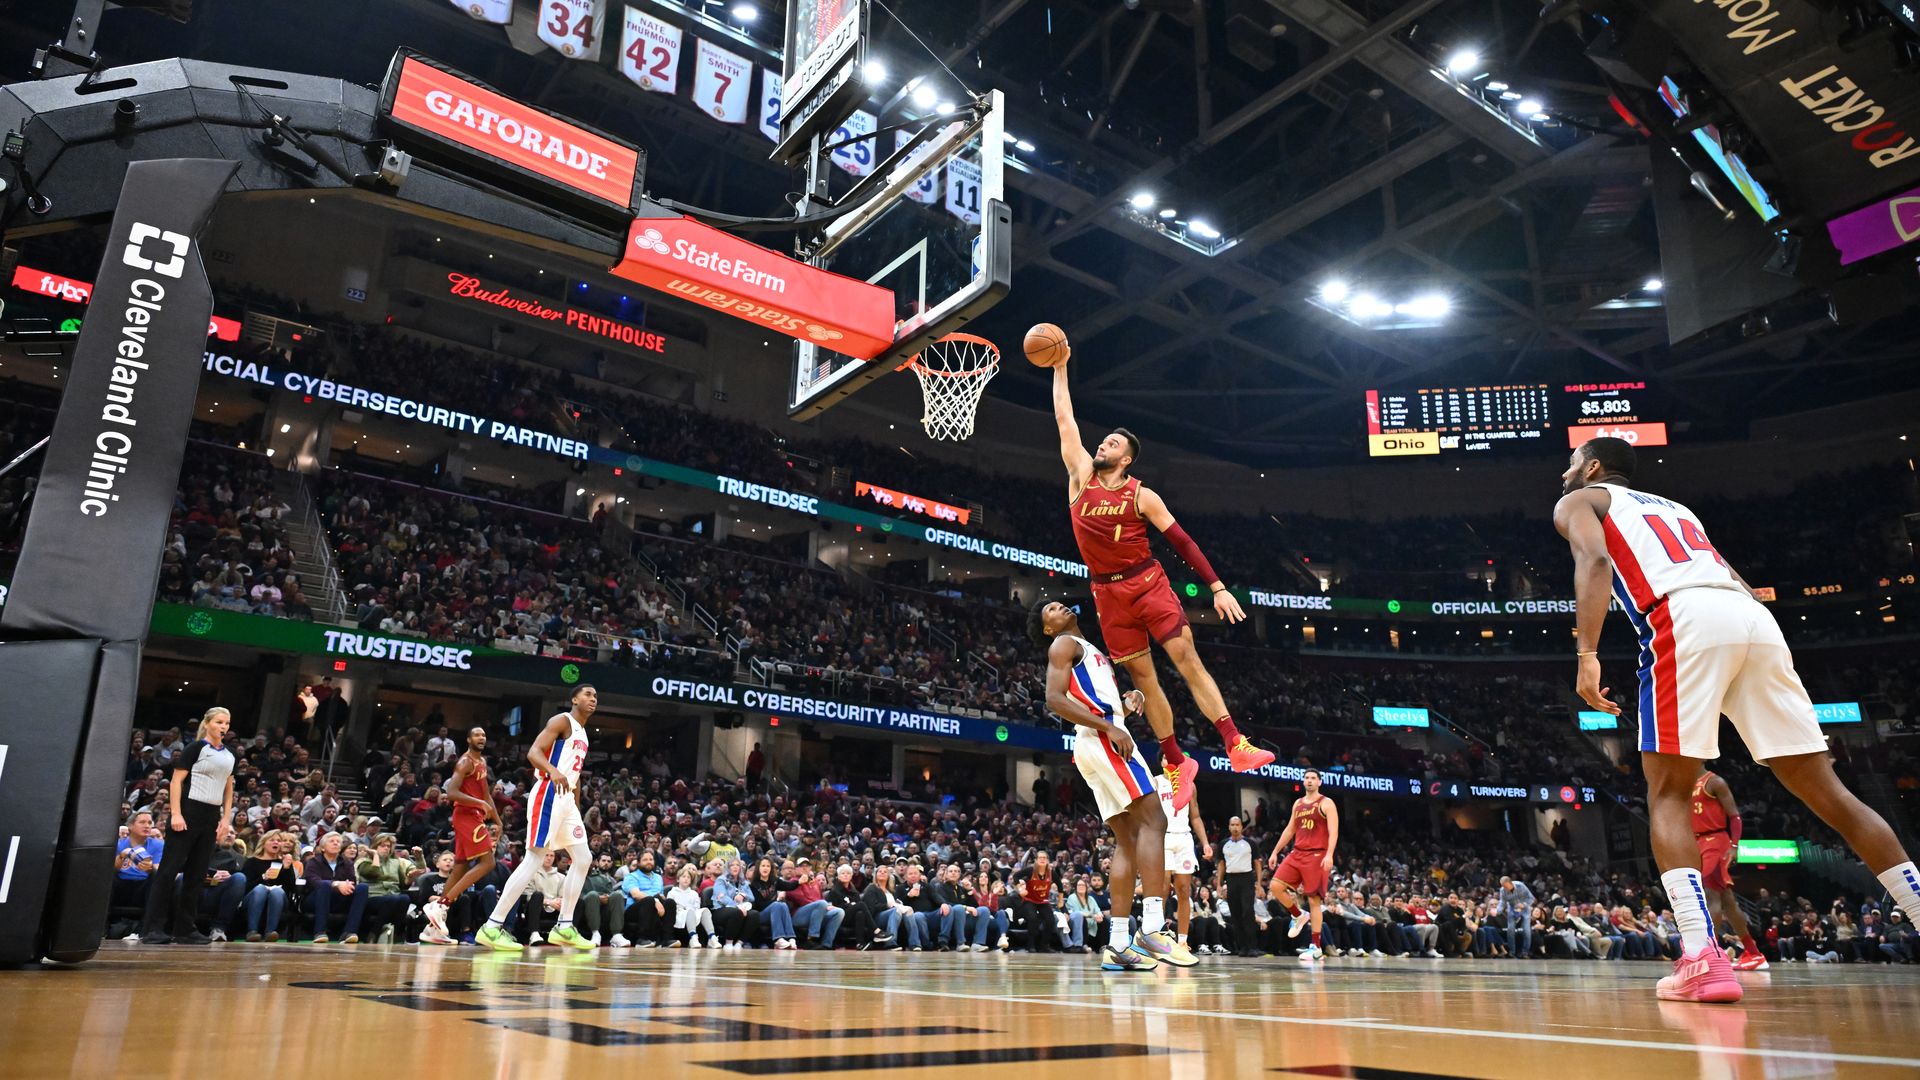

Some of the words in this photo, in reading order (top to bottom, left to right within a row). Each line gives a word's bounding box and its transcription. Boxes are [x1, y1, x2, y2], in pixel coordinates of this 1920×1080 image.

[547, 2, 595, 49] 34
[626, 20, 677, 49] THURMOND
[639, 16, 666, 34] NATE
[626, 37, 671, 82] 42
[707, 58, 740, 77] SMITH
[714, 71, 732, 105] 7
[766, 97, 781, 130] 2
[1779, 64, 1920, 169] ROCKET
[425, 90, 609, 180] GATORADE
[834, 126, 871, 165] 25
[954, 180, 980, 214] 11
[40, 276, 88, 301] fubo
[447, 271, 563, 322] Budweiser
[566, 308, 666, 353] PENTHOUSE
[102, 278, 166, 426] Cleveland
[1599, 381, 1646, 391] RAFFLE
[201, 352, 275, 386] ICIAL
[283, 371, 486, 434] CYBERSECURITY
[490, 421, 589, 461] PARTNER
[1581, 399, 1631, 416] $5,803
[1383, 439, 1425, 450] Ohio
[79, 430, 132, 517] Clinic
[716, 475, 818, 515] TRUSTEDSEC
[1080, 500, 1128, 517] Land
[1113, 523, 1122, 542] 1
[1642, 514, 1727, 569] 14
[924, 527, 989, 556] OFFICIAL
[991, 543, 1089, 579] CYBERSECURIT
[1249, 591, 1332, 611] TRUSTEDSEC
[1803, 584, 1842, 596] $5,803
[1431, 601, 1501, 615] OFFICIAL
[324, 630, 473, 670] TRUSTEDSEC
[651, 677, 738, 705] OFFICIAL
[743, 689, 886, 726] CYBERSECURITY
[889, 710, 960, 736] PARTNER
[1815, 705, 1857, 720] eely's
[572, 754, 584, 773] 2
[1260, 764, 1341, 787] CYBERSERITY
[1343, 775, 1394, 792] PARTNER
[1411, 785, 1421, 795] 60
[1450, 784, 1458, 797] 4
[1470, 785, 1527, 798] TURNOVERS
[1540, 787, 1549, 800] 9
[1583, 793, 1595, 803] 51
[1693, 801, 1703, 814] 3
[1301, 818, 1314, 830] 20
